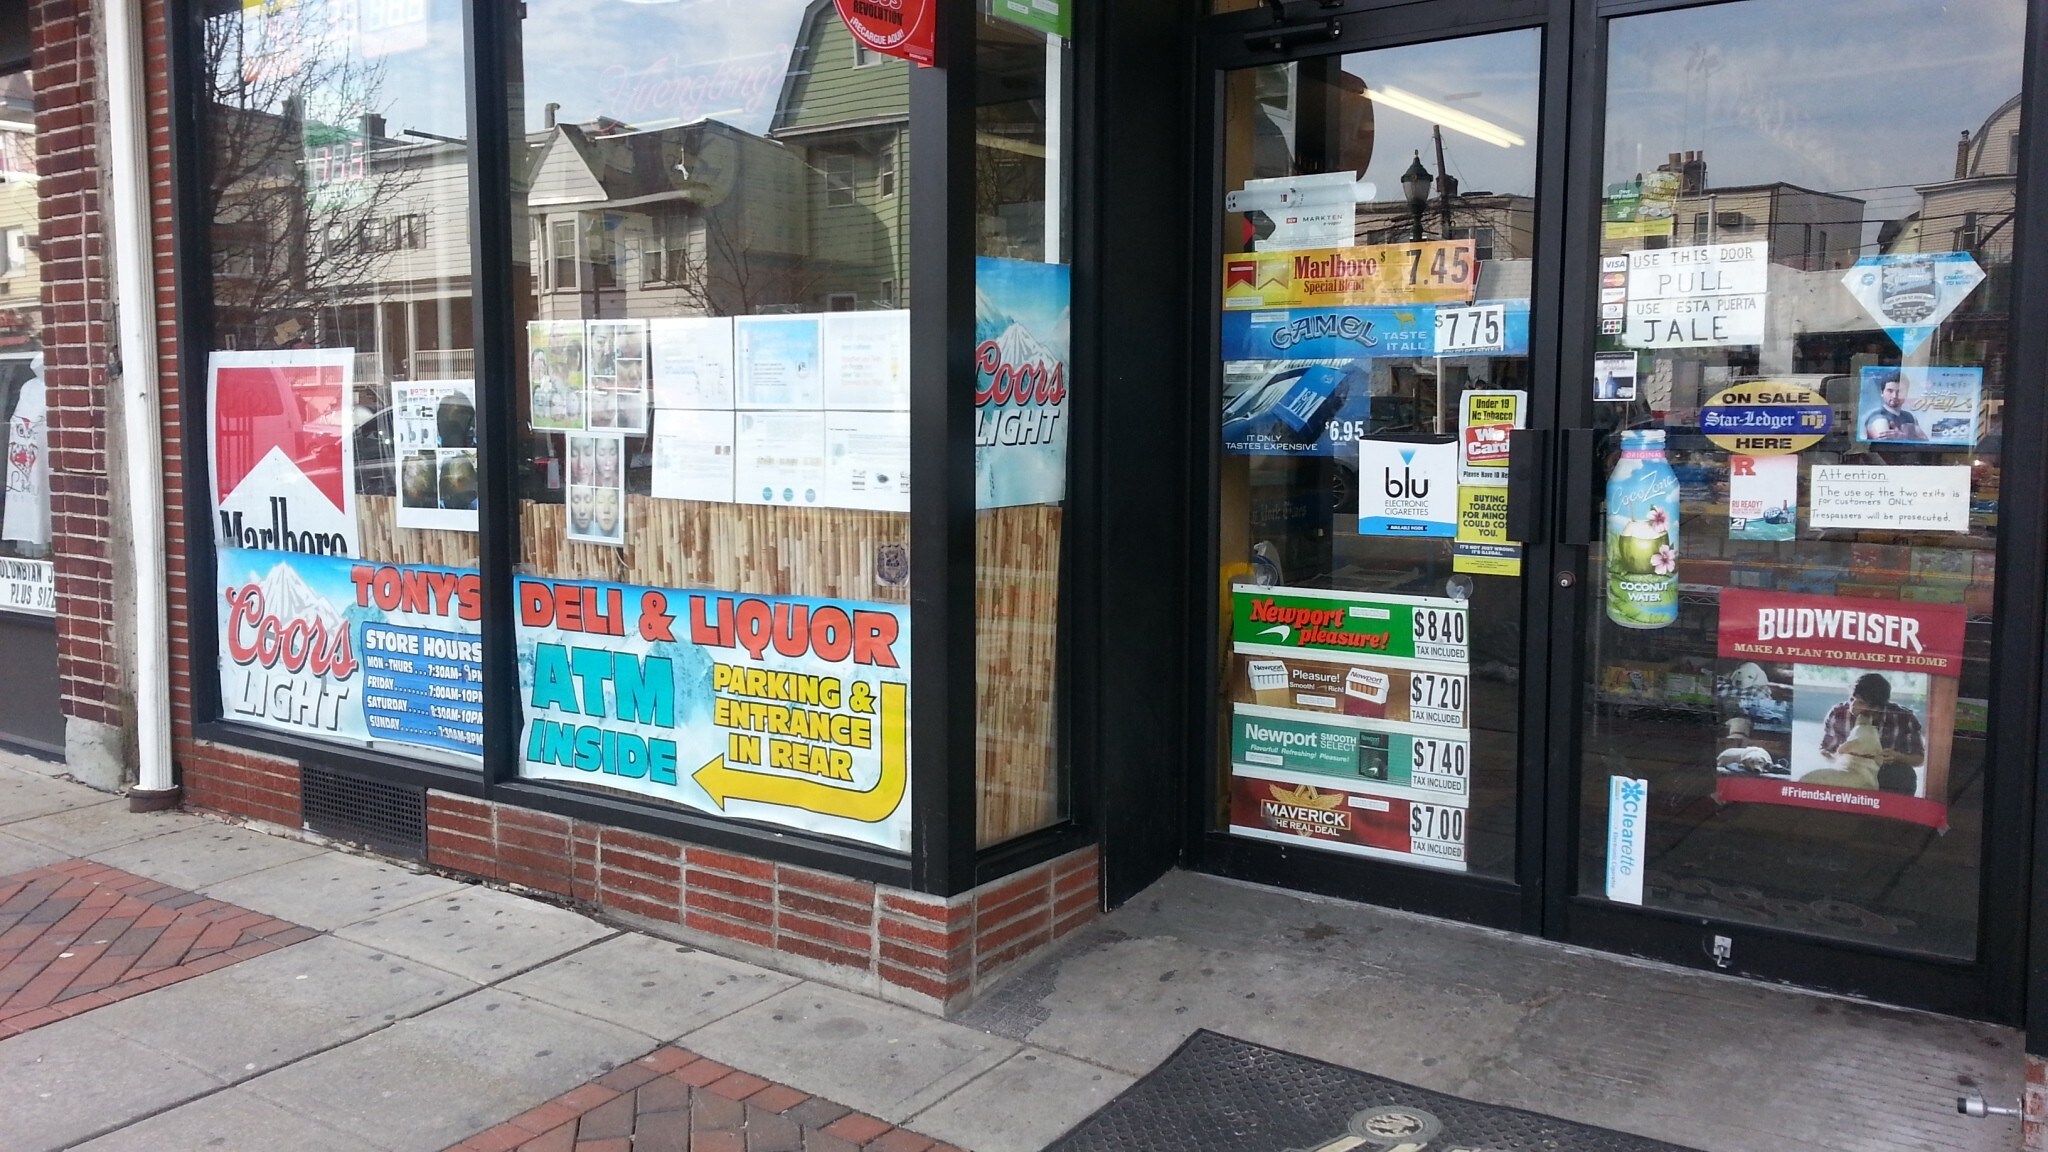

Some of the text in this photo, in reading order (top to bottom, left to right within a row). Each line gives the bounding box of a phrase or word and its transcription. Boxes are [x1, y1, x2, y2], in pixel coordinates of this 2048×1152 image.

[853, 1, 904, 26] REVOLUTION
[1294, 246, 1470, 285] Marlboro 7.45
[1605, 260, 1625, 269] VISA
[1633, 247, 1753, 268] USE THIS DOOR
[1304, 277, 1365, 294] Special Blend
[1658, 271, 1733, 295] PULL
[1636, 298, 1756, 315] USE ESTA PUERTA
[1270, 314, 1378, 350] CAMEL
[1382, 331, 1427, 340] TASTE
[1643, 316, 1729, 342] JALE
[1387, 342, 1426, 351] IT ALL
[976, 340, 1067, 406] Coors
[1476, 398, 1510, 409] Under 19
[1722, 392, 1811, 404] ON SALE
[976, 408, 1061, 447] LIGHT
[1472, 411, 1513, 421] No Tobacco
[1704, 411, 1795, 429] Star-Ledger
[1264, 443, 1318, 451] EXPENSIVE
[1468, 440, 1510, 455] Card
[1736, 438, 1793, 449] HERE
[1734, 456, 1756, 476] R
[1385, 466, 1429, 498] blu
[1817, 486, 1841, 497] The
[1864, 490, 1875, 498] of
[1878, 487, 1895, 497] the
[1900, 487, 1918, 497] two
[1922, 489, 1945, 497] exits
[1469, 503, 1508, 511] TOBACCO
[1474, 494, 1505, 503] BUYING
[1741, 500, 1763, 508] READY?
[1818, 498, 1831, 506] for
[1835, 498, 1881, 506] customers
[1384, 508, 1429, 516] CIGARETTES
[1463, 511, 1508, 520] FOR MINO
[1811, 508, 1862, 522] Trespassers
[1867, 512, 1880, 520] will
[1898, 512, 1951, 524] prosecuted.
[219, 496, 347, 557] Marlboro
[1463, 520, 1490, 528] COULD
[1479, 529, 1498, 537] YOU.
[11, 583, 32, 605] PLUS
[1620, 582, 1669, 592] COCONUT
[1627, 592, 1662, 602] WATER
[351, 563, 900, 668] TONY'S DELI & LIQUOR
[1250, 598, 1345, 629] Newport
[225, 584, 359, 682] Coors
[1298, 625, 1465, 658] pleasure! TAX INCLUDED
[1758, 608, 1923, 654] BUDWEISER
[366, 629, 482, 663] STORE HOURS
[1734, 643, 1948, 667] MAKE A PLAN TO MAKE IT HOME
[531, 642, 675, 729] ATM
[713, 662, 877, 714] PARKING &
[1253, 664, 1461, 710] Newport Pleasure! Newport $7.20
[234, 671, 348, 732] LIGHT
[1289, 681, 1460, 724] Smooth! Rich! TAX INCLUDED
[713, 696, 872, 749] ENTRANCE
[527, 718, 677, 786] INSIDE
[729, 732, 855, 782] IN REAR
[1245, 723, 1465, 776] Newport SMOOTH $7.40
[1250, 744, 1350, 763] Flavorful! Refreshing! Pleasure!
[1320, 740, 1461, 791] SELECT TAX INCLUDED
[1781, 786, 1880, 809] #FriendsAreWaiting
[1265, 802, 1462, 841] MAVERICK $7.00
[1290, 821, 1313, 832] REAL
[1315, 825, 1340, 836] DEAL
[1413, 841, 1426, 851] TAX
[1427, 842, 1461, 857] INCLUDED
[1620, 800, 1638, 876] Clearette
